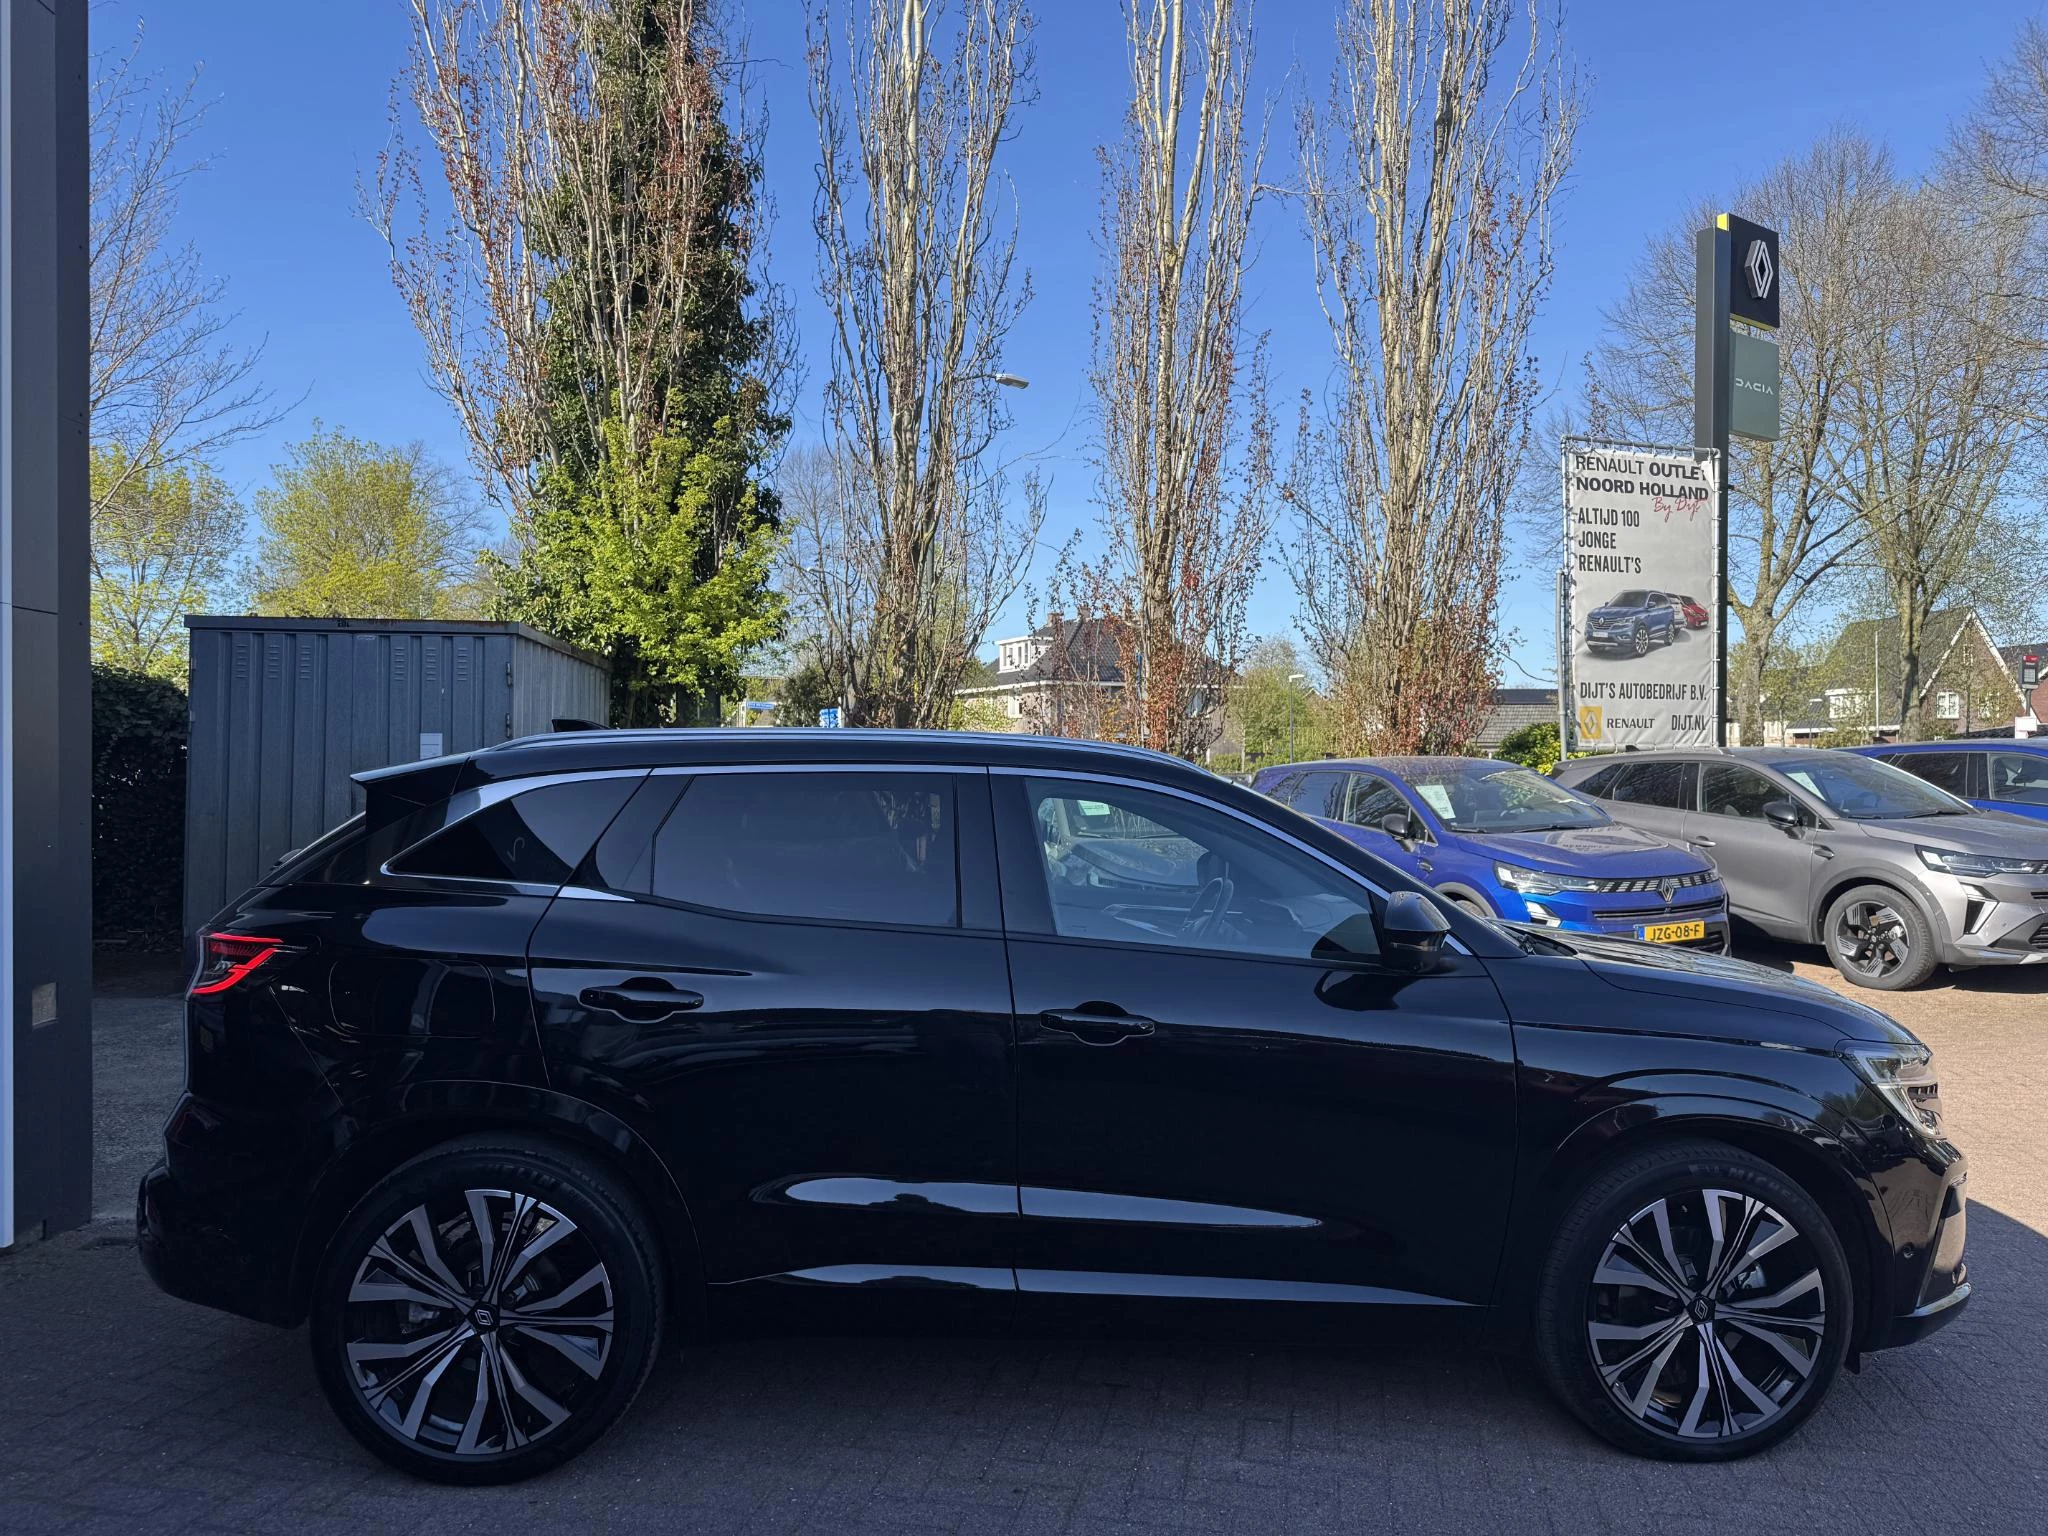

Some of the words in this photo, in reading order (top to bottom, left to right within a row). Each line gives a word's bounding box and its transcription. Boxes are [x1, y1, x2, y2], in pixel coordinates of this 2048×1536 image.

[1735, 377, 1773, 395] DACIA
[1575, 455, 1645, 475] RENAULT
[1576, 477, 1635, 494] NOORD
[1639, 482, 1709, 501] HOLLAND
[1578, 507, 1619, 526] ALTIJD
[1621, 510, 1640, 528] 100
[1578, 531, 1617, 550] JONGE
[1578, 555, 1642, 574] RENAULT'S
[1580, 682, 1616, 699] DIJT'S
[1618, 683, 1688, 700] AUTOBEDRIJF
[1690, 684, 1707, 701] B.V.
[1607, 718, 1656, 729] RENAULT
[1650, 924, 1700, 940] JZG-08-F
